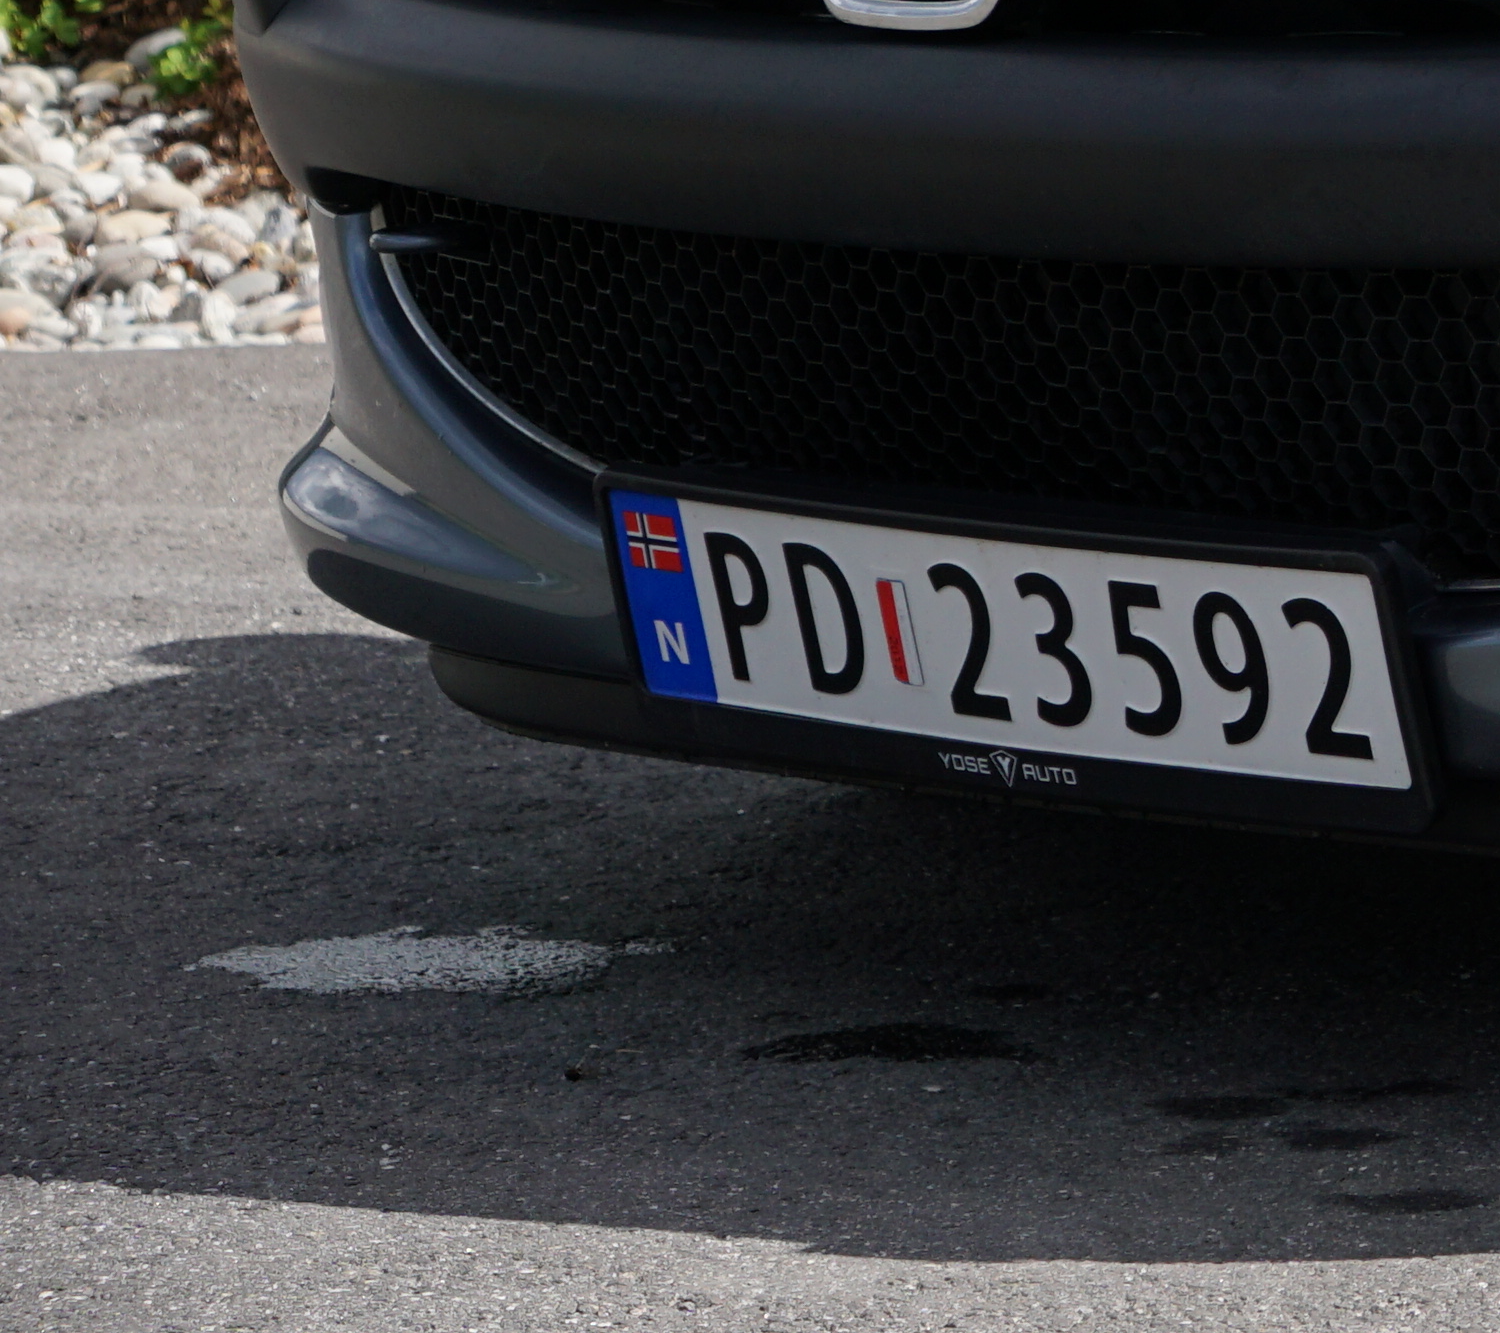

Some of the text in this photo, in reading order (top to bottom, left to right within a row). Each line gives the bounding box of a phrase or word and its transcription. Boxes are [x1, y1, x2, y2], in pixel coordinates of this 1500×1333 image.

[654, 618, 690, 666] N
[704, 531, 1376, 760] PD 23592
[938, 751, 991, 775] YOSE
[1021, 763, 1077, 785] AUTO
